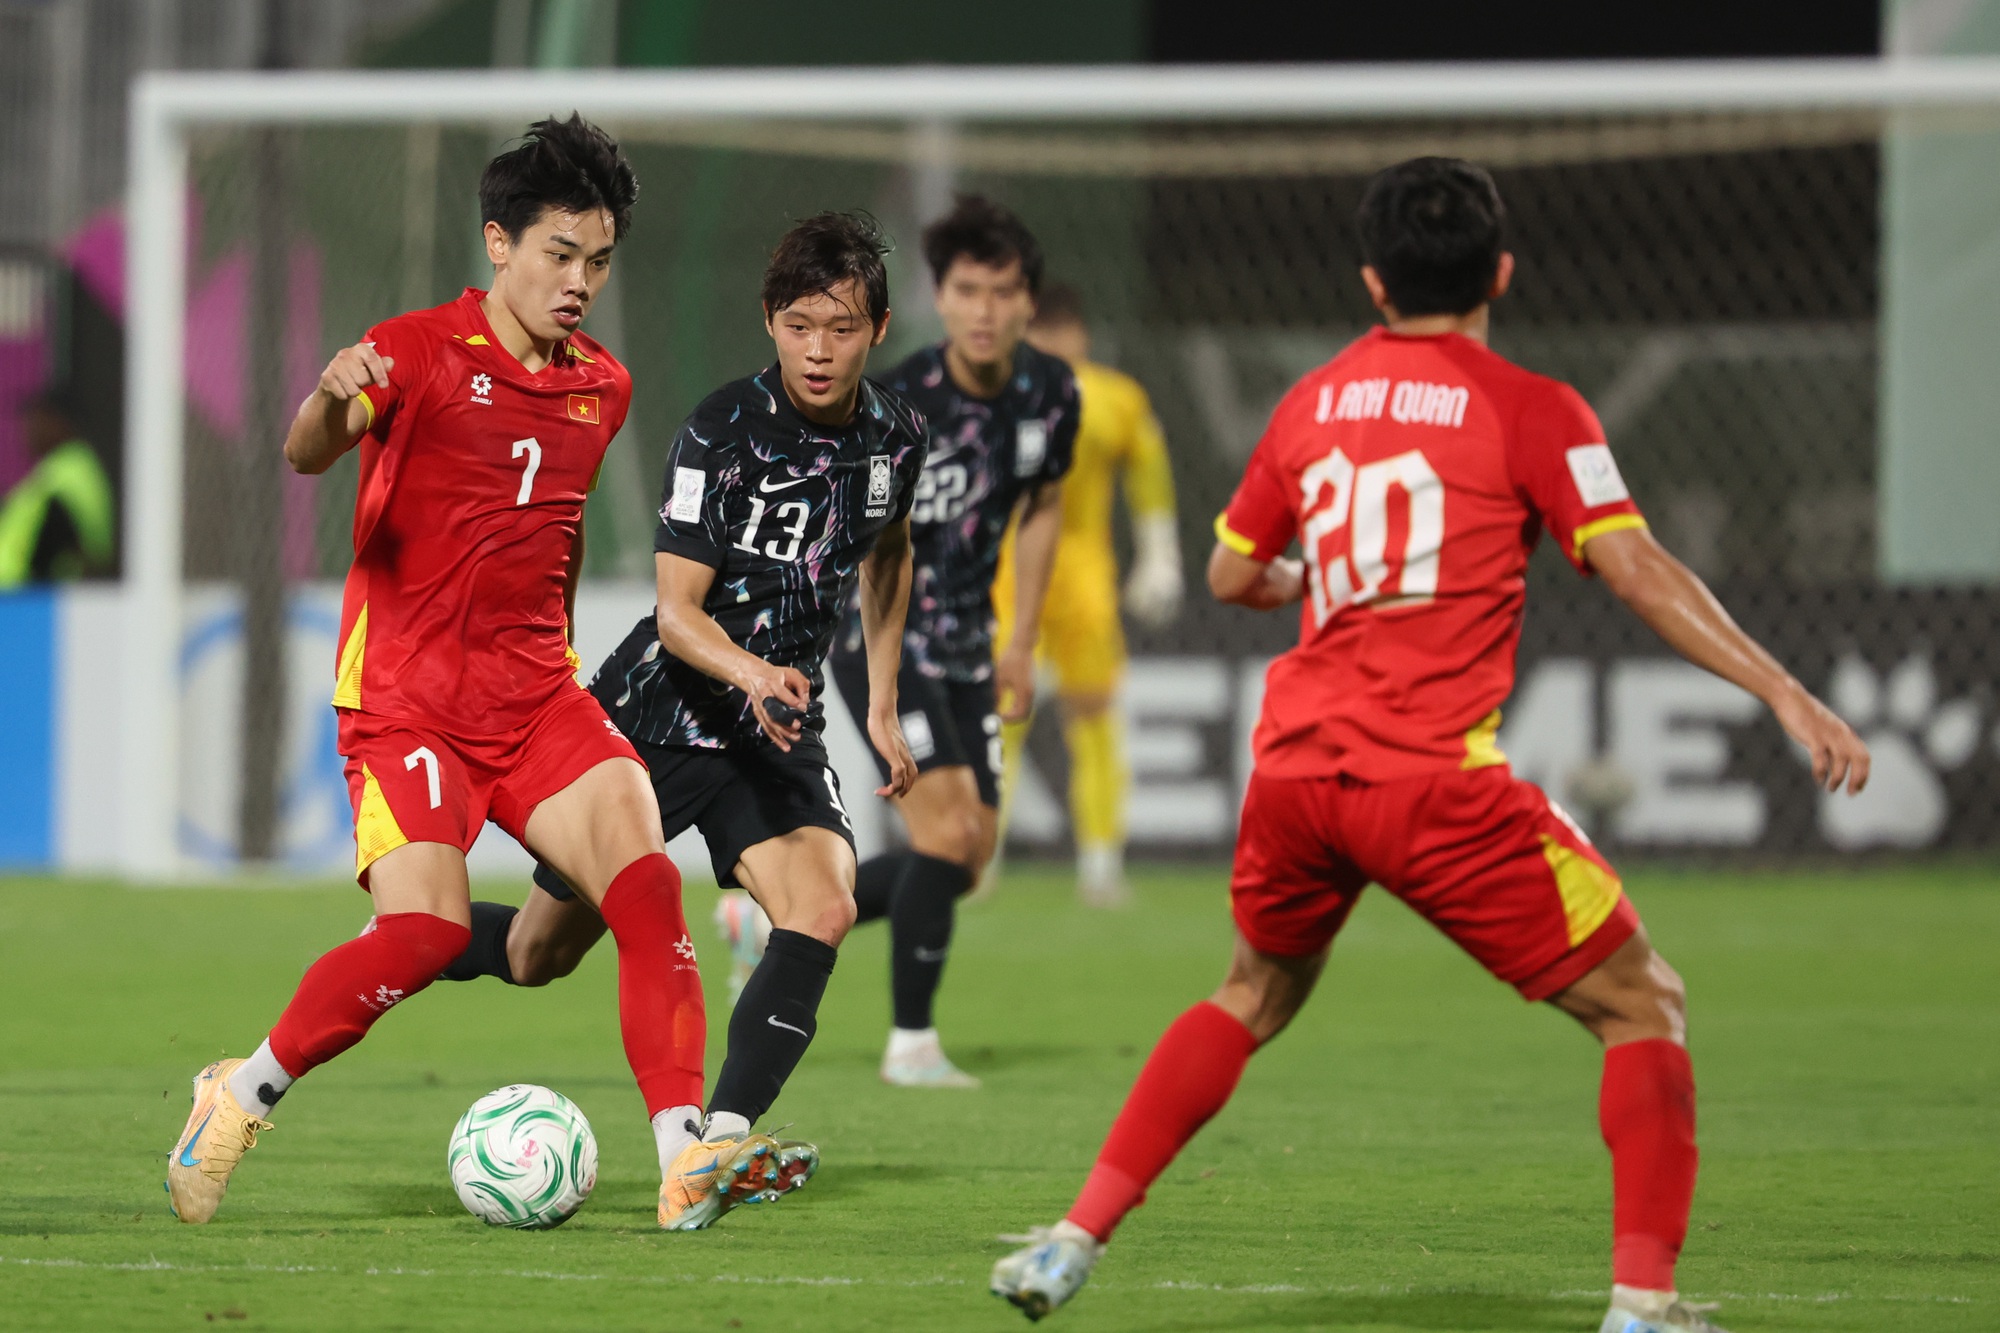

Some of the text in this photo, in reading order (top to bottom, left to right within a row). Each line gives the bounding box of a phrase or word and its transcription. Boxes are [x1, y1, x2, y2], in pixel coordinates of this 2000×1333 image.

[1390, 379, 1469, 429] QUAN
[511, 436, 542, 506] 7
[732, 496, 810, 562] 13
[865, 508, 887, 518] KOREA
[1299, 446, 1446, 630] 20
[403, 745, 442, 810] 7
